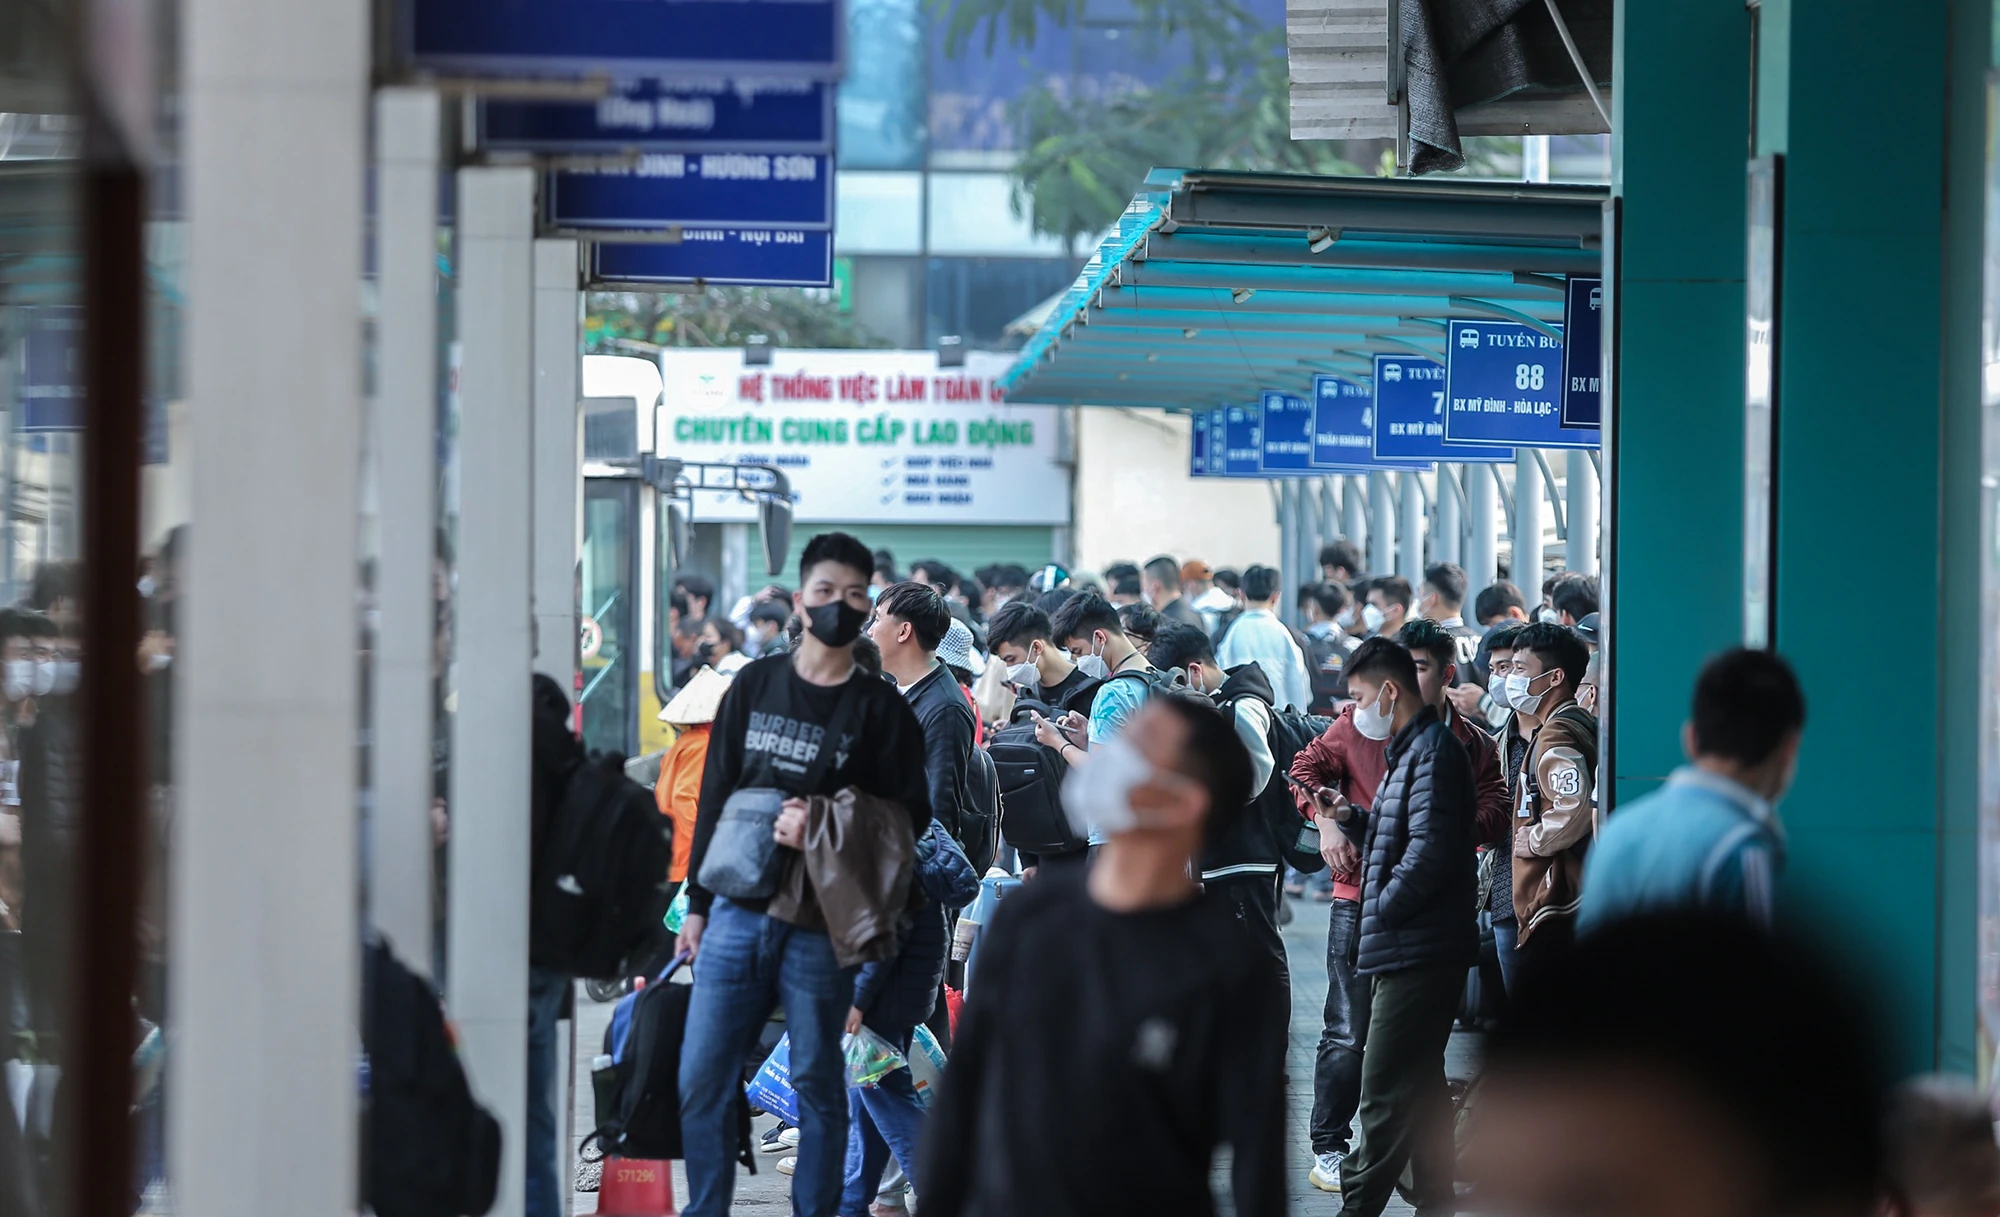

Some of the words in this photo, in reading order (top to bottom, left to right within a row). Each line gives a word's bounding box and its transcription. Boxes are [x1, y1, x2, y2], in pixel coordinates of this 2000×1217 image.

[739, 373, 763, 404] HỆ
[771, 369, 833, 402] THỐNG
[839, 371, 877, 405] VIỆC
[886, 371, 925, 402] LÀM
[933, 371, 982, 402] TOÀN
[1515, 363, 1545, 391] 88
[1571, 376, 1586, 392] BX
[1589, 377, 1601, 392] M
[1453, 398, 1466, 411] BX
[1468, 397, 1482, 412] MỸ
[1484, 397, 1506, 413] ĐÌNH
[1514, 398, 1532, 414] HÒA
[1534, 401, 1551, 417] LẠC
[675, 412, 773, 444] CHUYÊN
[781, 416, 848, 444] CUNG
[856, 411, 905, 445] CẤP
[913, 417, 958, 446] LAO
[967, 414, 1033, 449] ĐỘNG
[1389, 423, 1405, 436] BX
[1407, 421, 1424, 436] MỸ
[617, 1169, 656, 1183] 571296
